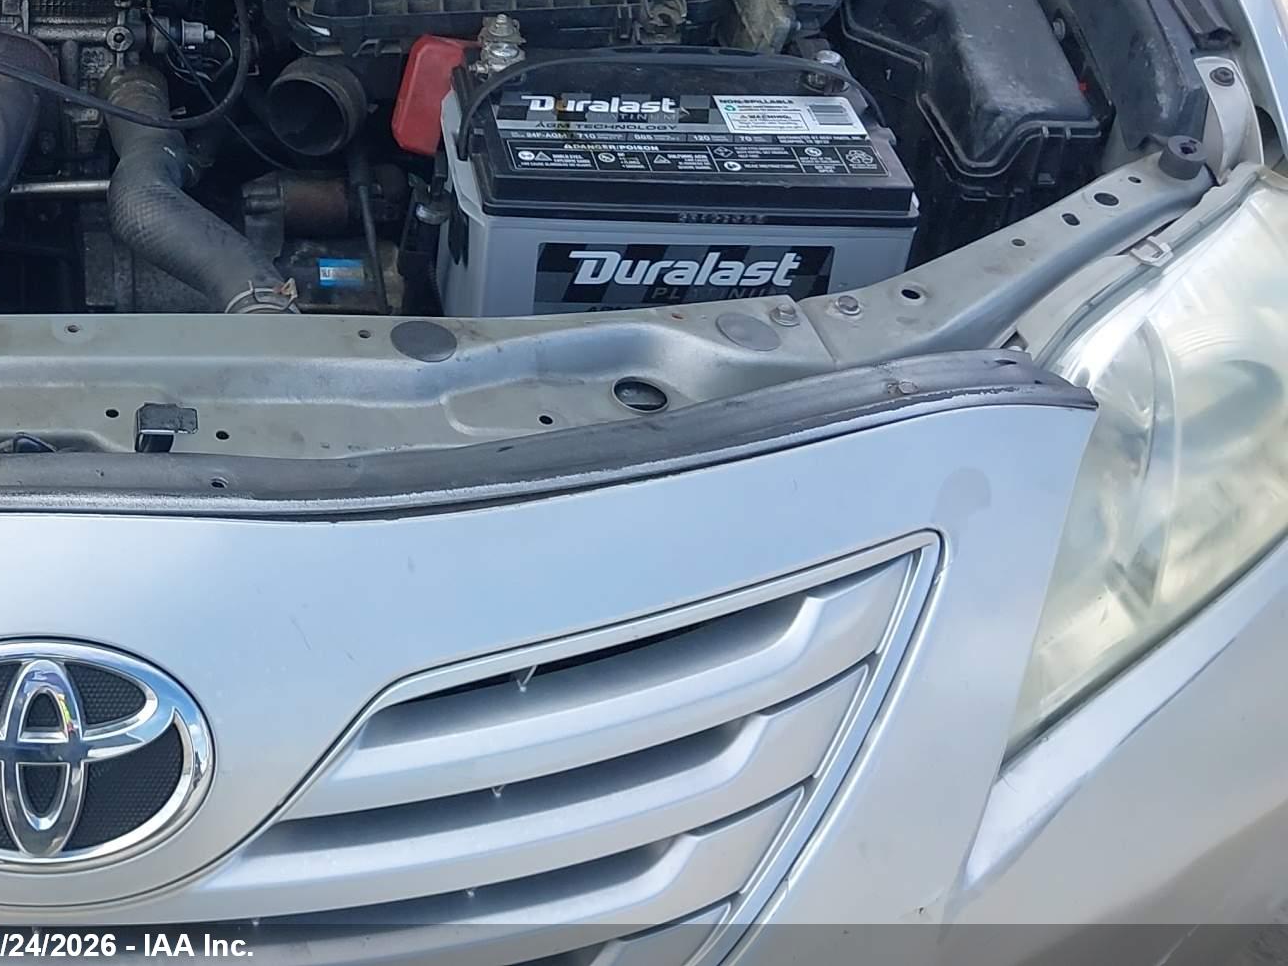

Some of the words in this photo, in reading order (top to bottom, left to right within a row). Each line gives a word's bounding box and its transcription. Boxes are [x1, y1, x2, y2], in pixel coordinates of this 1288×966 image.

[521, 95, 677, 114] Duralast
[536, 121, 569, 130] AGM
[575, 122, 678, 132] TECHNOLOGY
[693, 134, 711, 142] 120
[569, 250, 802, 287] Duralast
